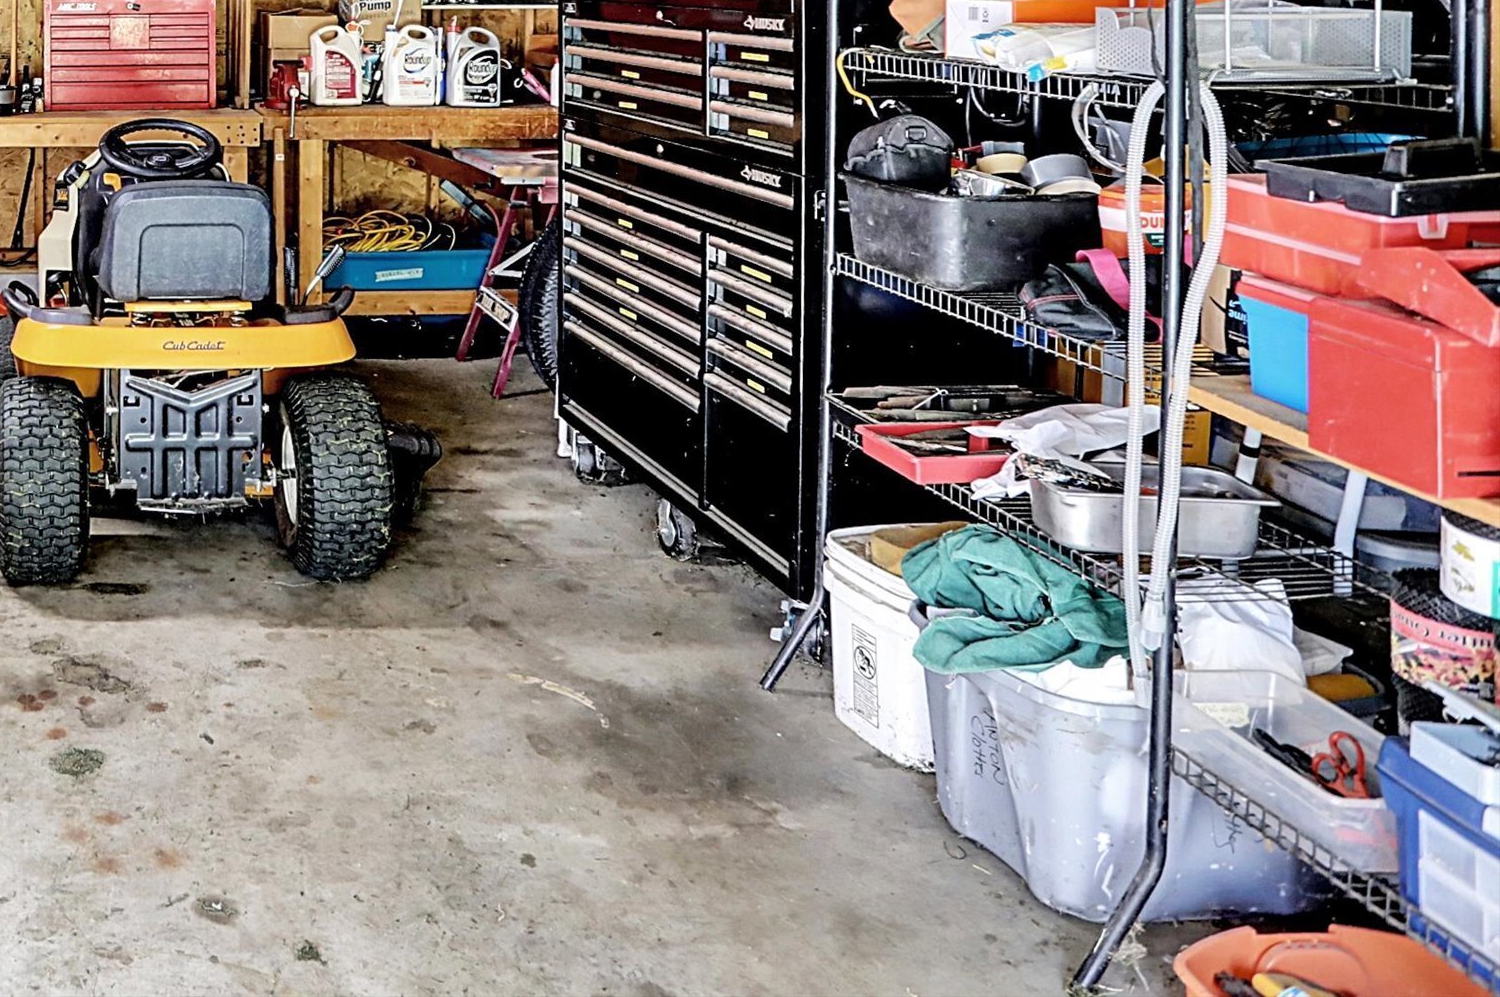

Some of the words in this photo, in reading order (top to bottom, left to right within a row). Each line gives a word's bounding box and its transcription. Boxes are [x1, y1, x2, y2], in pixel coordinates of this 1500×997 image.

[360, 1, 392, 11] Pump
[754, 17, 785, 31] HUSKY
[751, 167, 782, 188] HUSKY
[1228, 308, 1247, 324] ime
[162, 340, 186, 351] Cub
[187, 340, 226, 351] Cadet
